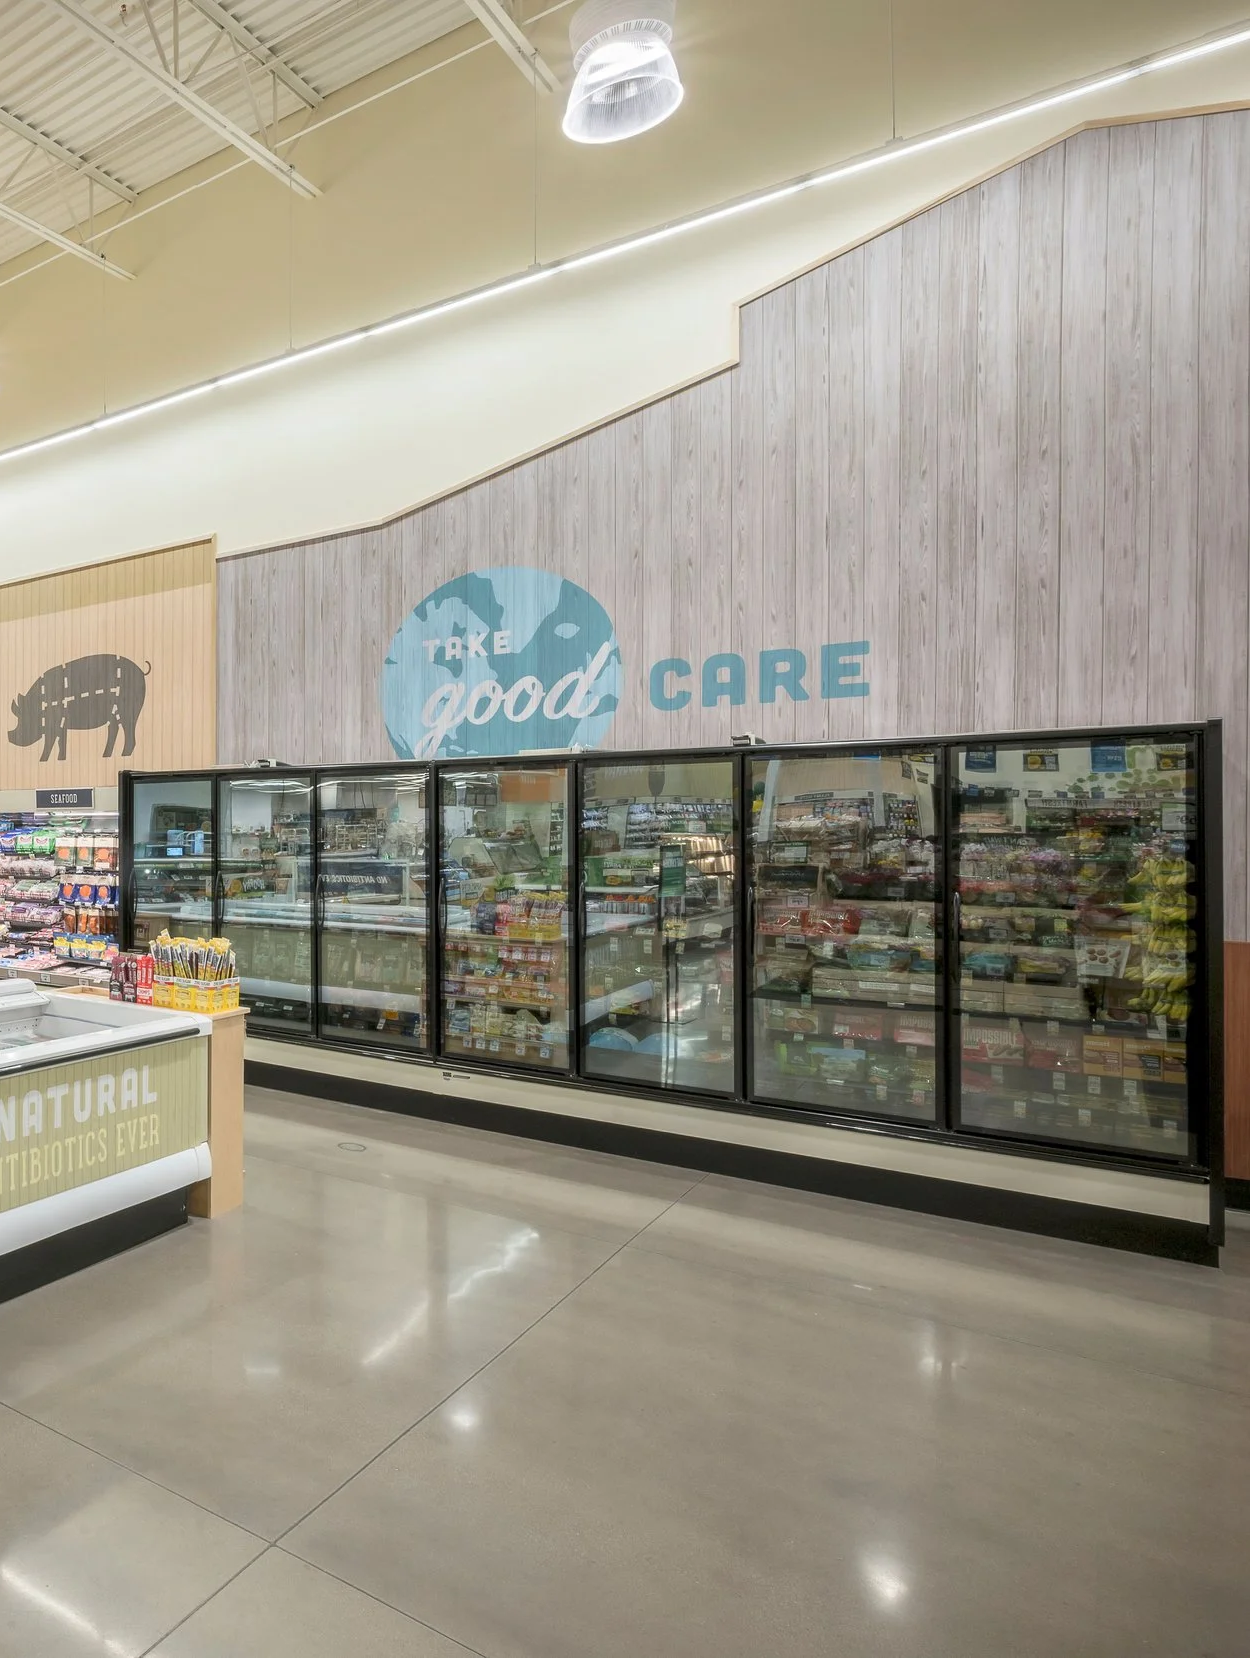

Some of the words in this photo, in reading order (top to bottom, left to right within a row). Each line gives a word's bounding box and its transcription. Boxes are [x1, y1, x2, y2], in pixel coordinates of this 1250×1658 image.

[422, 629, 512, 661] TAKE
[415, 640, 612, 760] good
[650, 640, 871, 712] CARE
[50, 794, 78, 804] SEAFOOD
[963, 1027, 1017, 1046] IMPOSSIBLE
[116, 1113, 160, 1158] EVER
